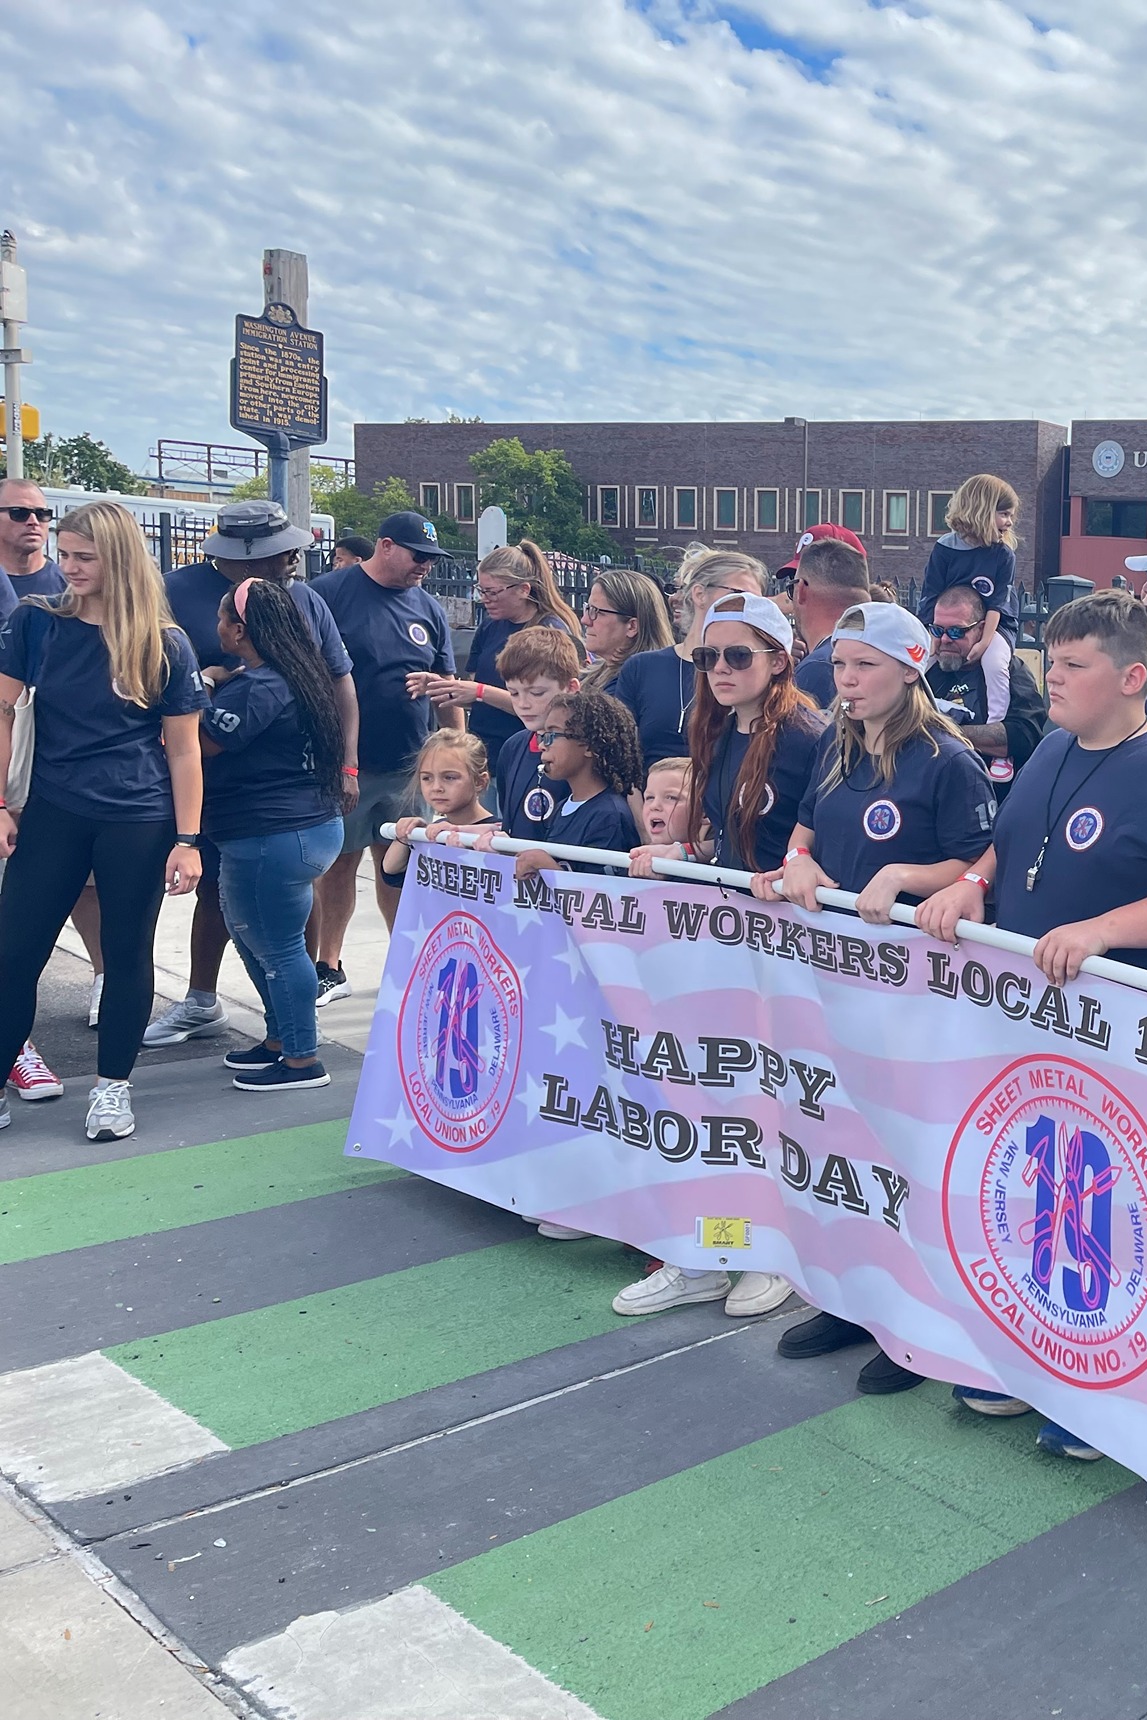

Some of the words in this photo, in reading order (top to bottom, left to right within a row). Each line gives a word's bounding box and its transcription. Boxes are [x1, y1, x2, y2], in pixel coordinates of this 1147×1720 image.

[242, 327, 288, 344] IMMIGRATION
[289, 338, 318, 351] STATION
[243, 320, 287, 336] WASHINGTON
[289, 331, 317, 343] AVENUE
[240, 341, 260, 352] Since
[264, 347, 277, 356] the
[307, 356, 320, 365] the
[240, 350, 266, 361] station
[268, 356, 282, 364] was
[297, 362, 320, 372] entry
[240, 356, 260, 366] point
[263, 362, 277, 370] and
[280, 366, 320, 379] processing
[240, 364, 264, 374] center
[265, 368, 276, 377] for
[240, 371, 275, 383] primarily
[275, 377, 293, 386] from
[293, 380, 320, 392] Eastern
[239, 392, 264, 401] moved
[268, 396, 284, 404] into
[287, 400, 300, 408] the
[304, 404, 320, 413] city
[240, 384, 259, 393] From
[281, 393, 320, 405] newcomers
[254, 379, 290, 393] Southern
[292, 387, 320, 399] Europe.
[239, 405, 260, 414] state.
[266, 409, 273, 417] It
[277, 412, 291, 420] was
[294, 415, 320, 425] demol-
[239, 412, 259, 421] ished
[273, 417, 291, 427] 1915.
[250, 400, 271, 409] other
[273, 405, 294, 414] parts
[307, 411, 320, 419] the
[211, 707, 241, 733] 19
[417, 853, 502, 904] SHEET
[513, 873, 647, 935] MTAL
[662, 900, 909, 987] WORKERS
[926, 951, 1113, 1052] LOCAL
[418, 933, 443, 981] SHEET
[447, 921, 474, 941] METAL
[478, 932, 519, 1020] WORKERS'
[422, 1012, 430, 1060] JERSEY
[488, 1007, 501, 1077] DELAWARE
[600, 1018, 836, 1122] HAPPY
[408, 1071, 432, 1126] LOCAL
[434, 1121, 466, 1144] UNION
[468, 1117, 489, 1142] NO.
[490, 1100, 501, 1117] 19
[430, 1079, 479, 1110] PENNSYLVANIA
[975, 1077, 1024, 1137] SHEET
[1028, 1067, 1089, 1101] METAL
[539, 1072, 767, 1170] LABOR
[778, 1130, 911, 1233] DAY
[999, 1139, 1020, 1176] NEW
[994, 1177, 1013, 1244] JERSEY
[1025, 1114, 1113, 1313] 19
[1125, 1200, 1146, 1299] DELAWARE
[1021, 1272, 1108, 1329] PENNSYLVANIA
[969, 1257, 1027, 1335] LOCAL
[1031, 1325, 1089, 1375] UNION
[1093, 1348, 1126, 1376] NO.
[1127, 1330, 1147, 1353] 19
